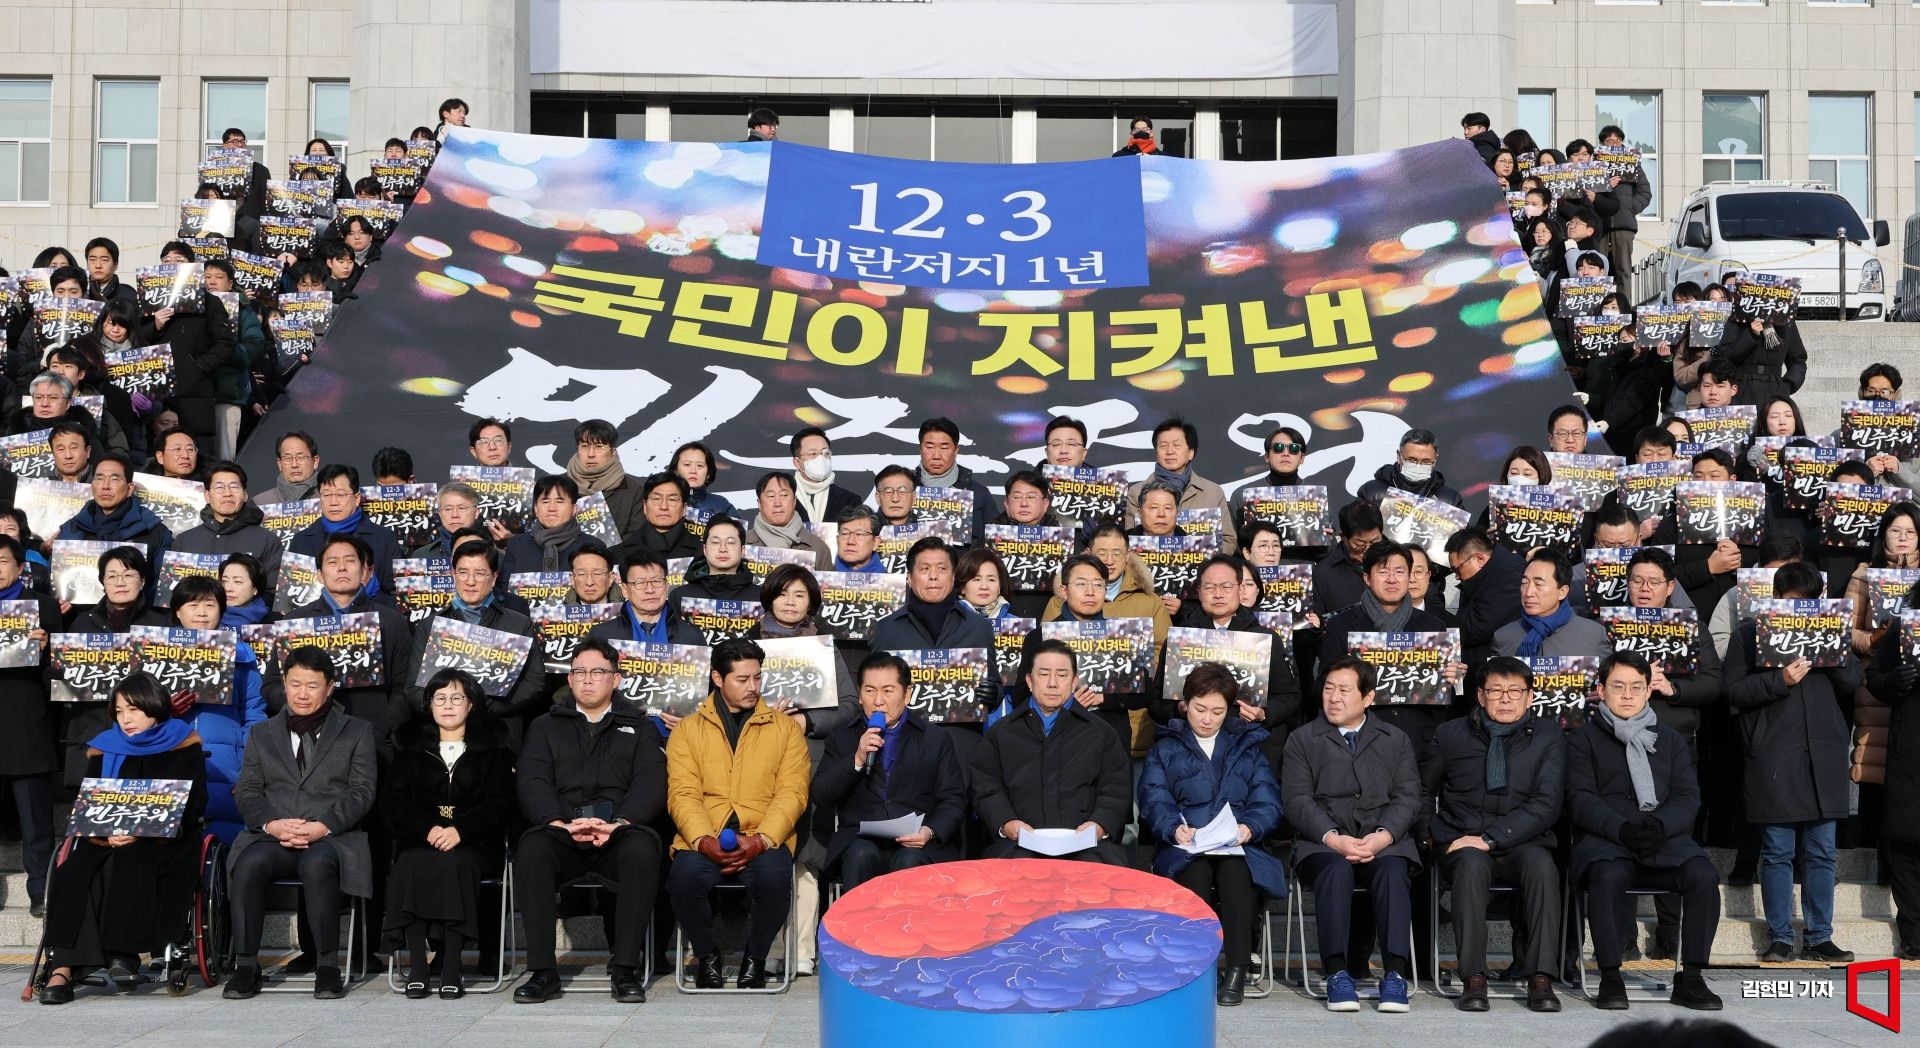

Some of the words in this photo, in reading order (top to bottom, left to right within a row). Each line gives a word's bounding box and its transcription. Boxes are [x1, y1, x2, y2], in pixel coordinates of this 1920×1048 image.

[268, 226, 287, 236] 국민이
[289, 227, 309, 236] 지켜낸
[267, 236, 309, 250] 민주주의
[235, 260, 254, 272] 국민이
[254, 264, 274, 276] 지켜낸
[790, 236, 1008, 288] 내란저지
[1029, 250, 1108, 288] 1년
[144, 276, 167, 288] 국민이
[233, 270, 272, 289] 민주주의
[1567, 286, 1585, 296] 국민이
[1741, 285, 1764, 296] 국민이
[1765, 287, 1791, 299] 지켜낸
[284, 302, 303, 312] 국민이
[304, 302, 324, 311] 지켜낸
[1739, 296, 1789, 317] 민주주의
[1814, 296, 1836, 306] 5820
[43, 311, 66, 320] 국민이
[69, 311, 95, 322] 지켜낸
[532, 263, 927, 375] 국민이
[972, 287, 1379, 382] 지켜낸
[1645, 314, 1667, 324] 국민이
[1700, 312, 1725, 323] 국민이
[42, 322, 93, 339] 민주주의
[281, 340, 313, 355] 민주주의
[107, 365, 135, 377] 국민이
[136, 361, 165, 372] 지켜낸
[1719, 419, 1748, 430] 지켜낸
[1854, 416, 1883, 427] 국민이
[1885, 416, 1913, 427] 지켜낸
[1852, 428, 1913, 447] 민주주의
[10, 445, 40, 458] 국민이
[1555, 467, 1583, 478] 국민이
[1586, 469, 1615, 480] 지켜낸
[1796, 463, 1824, 475] 국민이
[493, 483, 522, 493] 지켜낸
[1054, 481, 1084, 494] 국민이
[1086, 483, 1116, 496] 지켜낸
[1628, 479, 1656, 490] 국민이
[363, 501, 394, 513] 국민이
[396, 500, 426, 512] 지켜낸
[933, 501, 962, 512] 지켜낸
[1052, 495, 1115, 518] 민주주의
[1256, 501, 1286, 513] 국민이
[1289, 500, 1317, 512] 지켜낸
[1627, 490, 1675, 513] 민주주
[1724, 497, 1755, 510] 지켜낸
[1837, 500, 1869, 513] 국민이
[1508, 507, 1540, 521] 국민이
[1542, 510, 1573, 523] 지켜낸
[1506, 522, 1571, 546] 민주주의
[997, 542, 1028, 554] 국민이
[1031, 543, 1062, 555] 지켜낸
[1140, 553, 1170, 565] 국민이
[1173, 553, 1204, 565] 지켜낸
[519, 587, 547, 598] 국민이
[1269, 581, 1300, 593] 지켜낸
[410, 593, 444, 605] 국민이
[823, 589, 856, 602] 국민이
[860, 590, 892, 602] 지켜낸
[694, 616, 726, 629] 국민이
[1771, 617, 1806, 629] 국민이
[1808, 617, 1841, 629] 지켜낸
[545, 624, 578, 636] 국민이
[1615, 623, 1649, 636] 국민이
[1652, 624, 1686, 637] 지켜낸
[332, 632, 367, 646] 지켜낸
[1097, 639, 1130, 652] 지켜낸
[1769, 631, 1841, 657] 민주주의
[65, 651, 99, 662] 국민이
[144, 645, 181, 660] 국민이
[184, 647, 221, 662] 지켜낸
[442, 637, 477, 657] 국민이
[479, 646, 515, 666] 지켜낸
[1182, 647, 1218, 661] 국민이
[1363, 651, 1399, 664] 국민이
[1402, 651, 1438, 664] 지켜낸
[621, 660, 656, 673] 국민이
[661, 661, 696, 676] 지켜낸
[937, 668, 973, 681] 지켜낸
[1547, 675, 1585, 688] 지켜낸
[621, 675, 695, 704] 민주주의
[1532, 690, 1586, 717] 주주의
[93, 793, 131, 804] 국민이
[134, 793, 173, 805] 지켜낸
[85, 805, 168, 825] 민주주의
